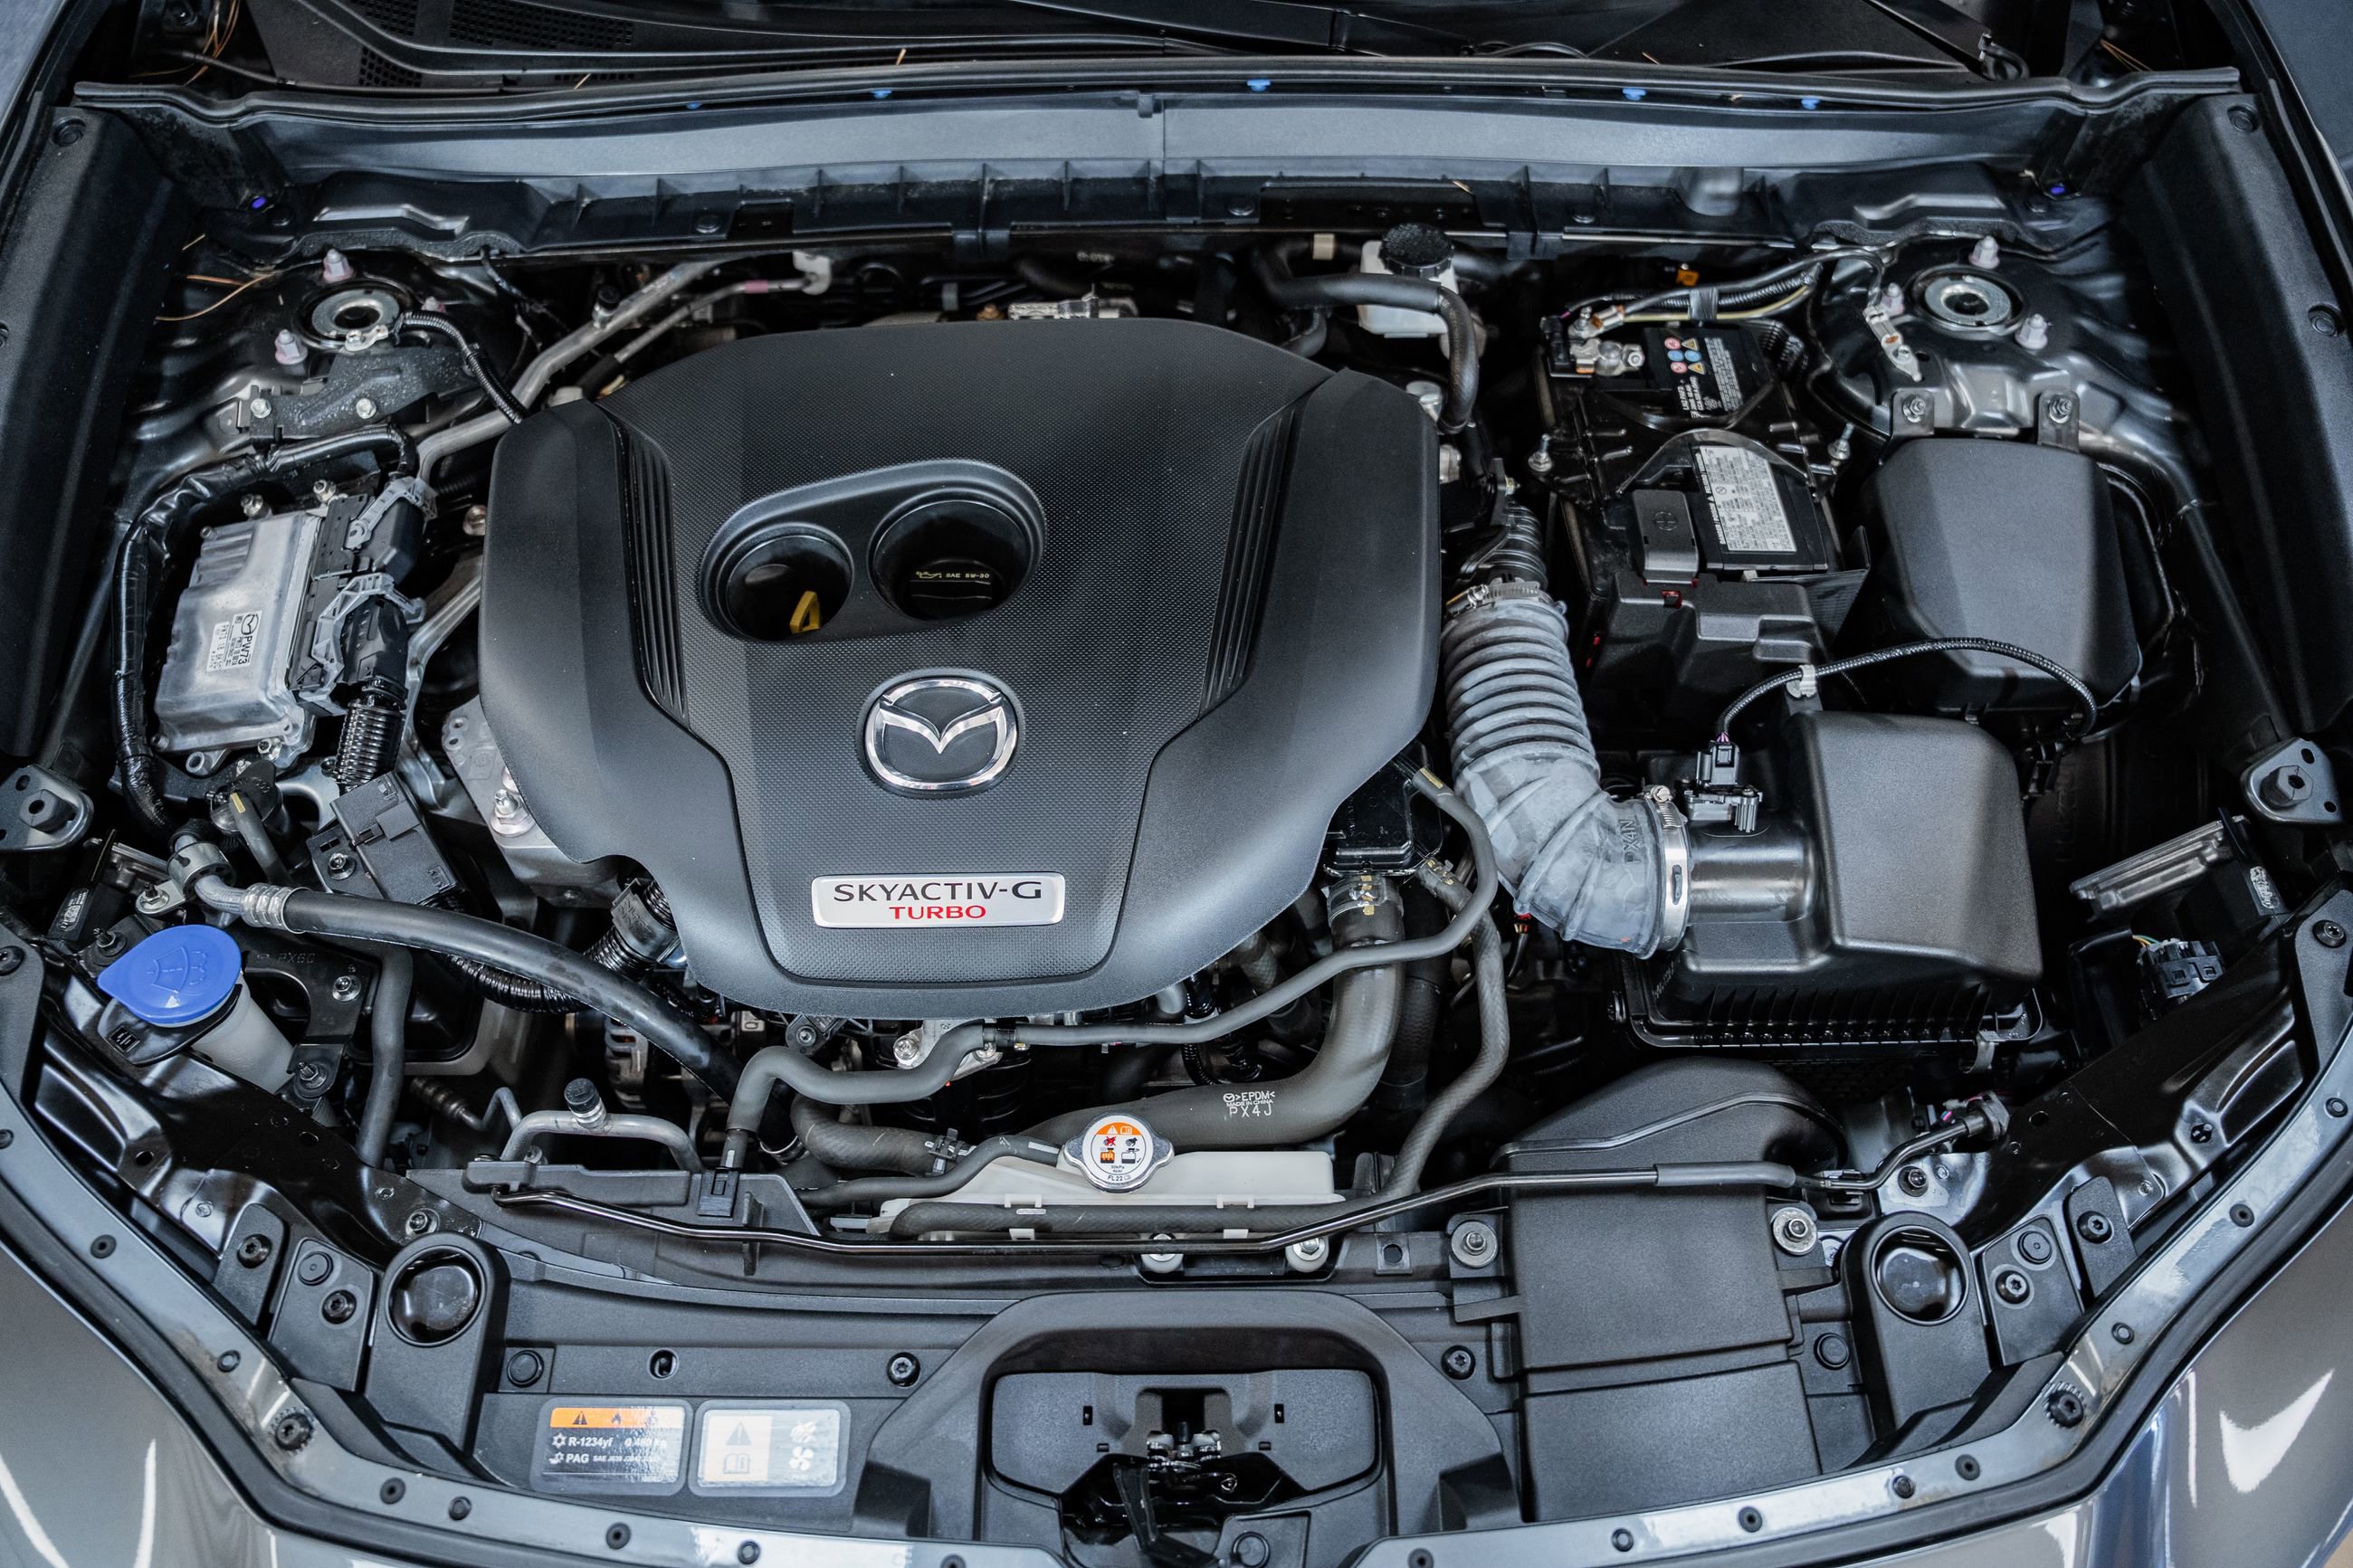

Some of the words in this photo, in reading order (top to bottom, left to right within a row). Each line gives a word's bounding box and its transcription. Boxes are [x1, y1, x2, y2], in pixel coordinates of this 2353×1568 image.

[238, 635, 253, 665] PW73
[834, 881, 1042, 902] SKYACTIV-G
[889, 905, 986, 920] TURBO
[567, 1437, 614, 1449] R-1234yf
[566, 1453, 589, 1464] PAG
